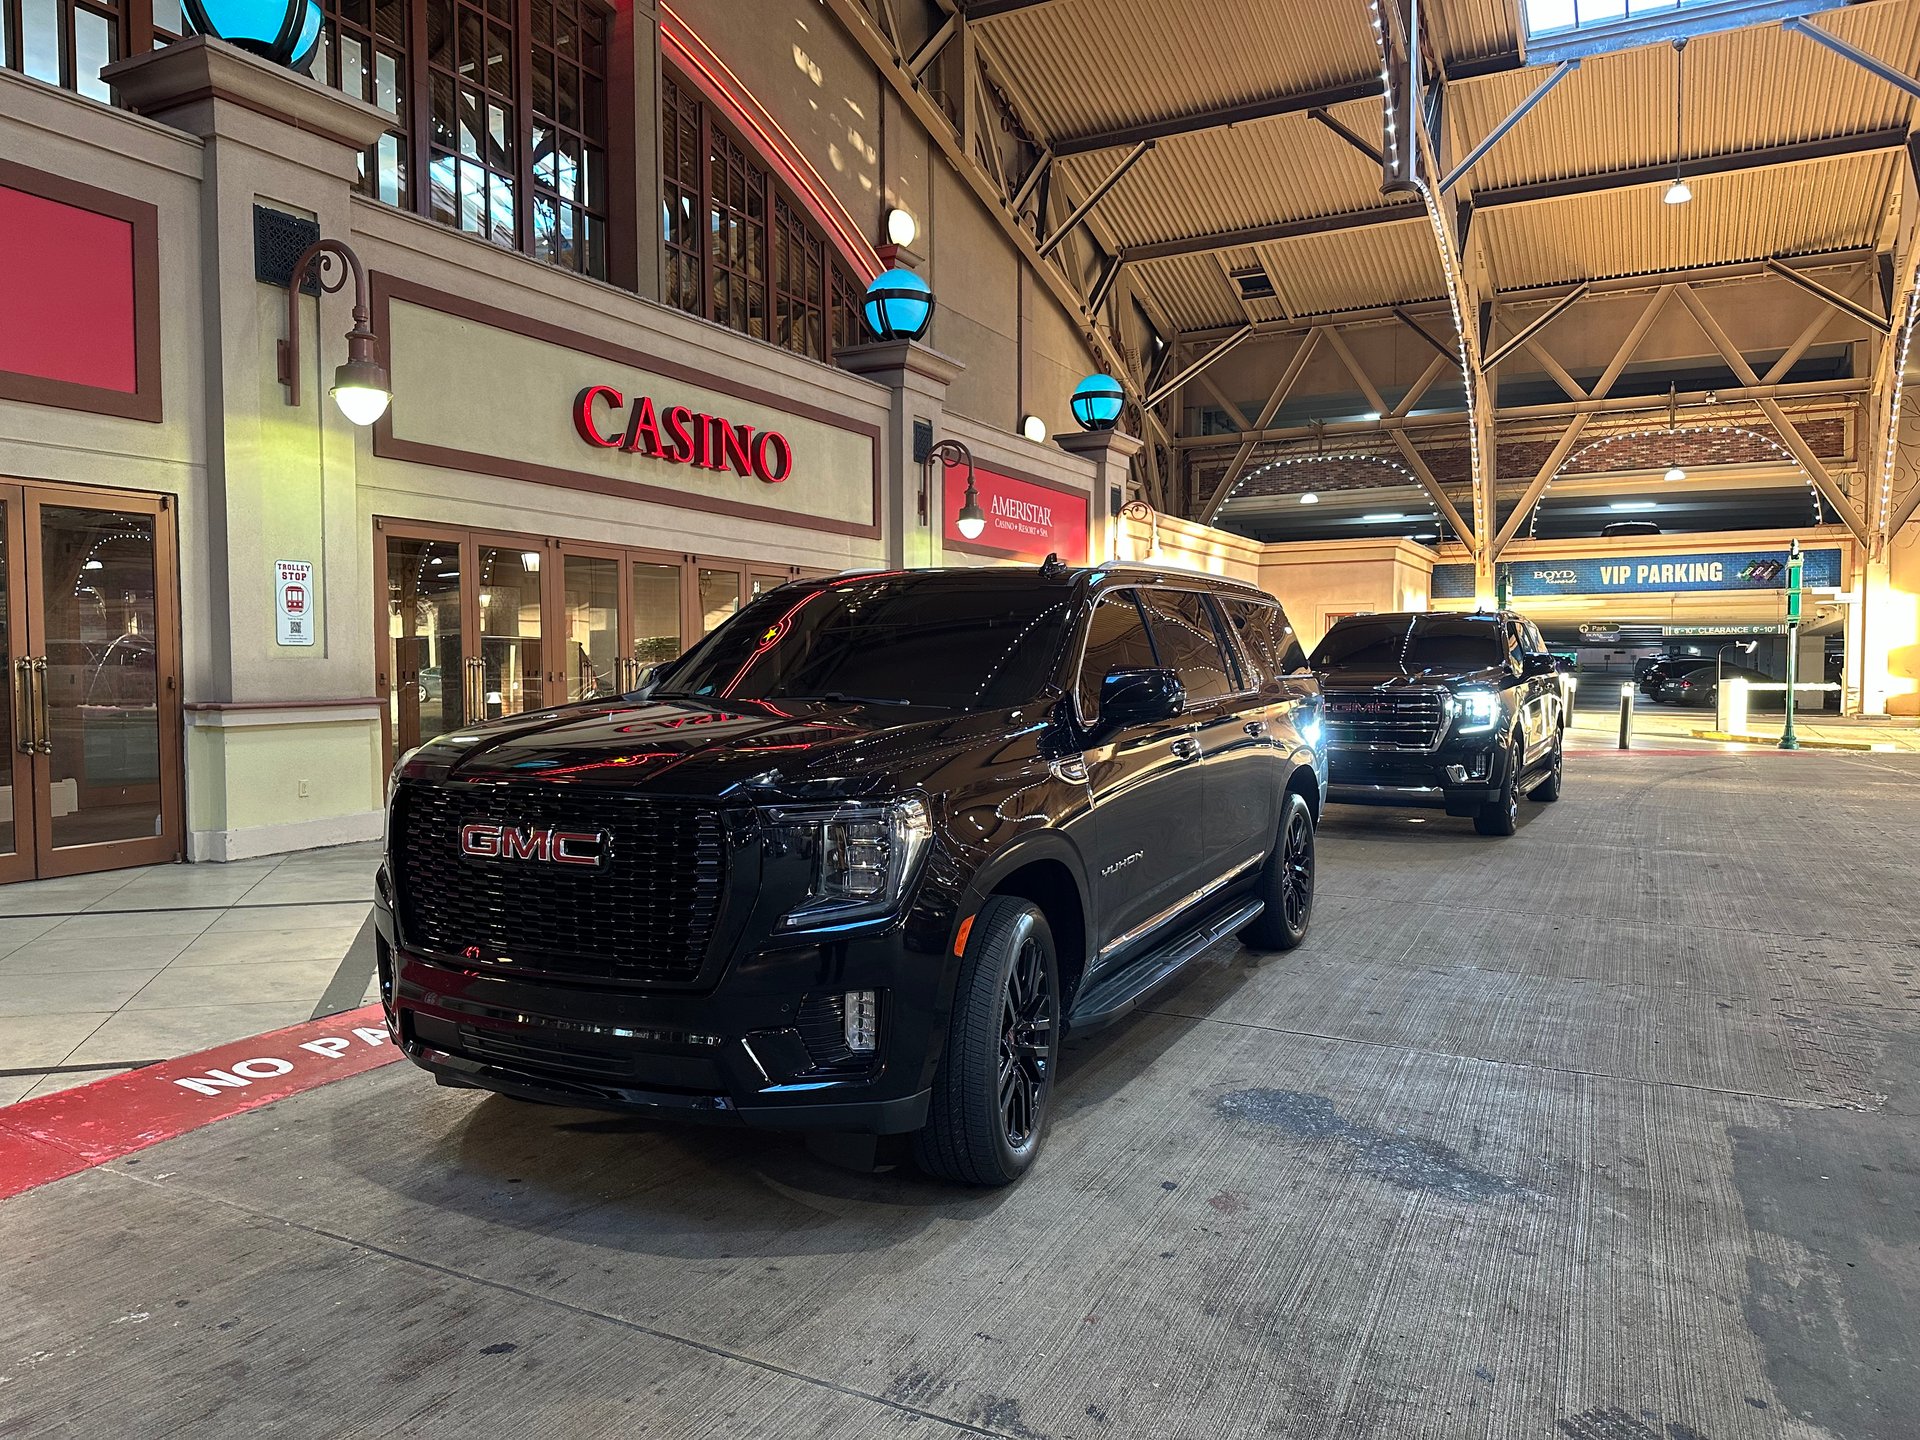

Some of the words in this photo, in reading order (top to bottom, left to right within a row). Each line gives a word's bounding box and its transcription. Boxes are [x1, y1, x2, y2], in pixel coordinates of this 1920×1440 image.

[573, 385, 792, 483] CASINO
[990, 494, 1053, 527] AMERISTAR
[277, 563, 311, 572] TROLLEY
[281, 571, 307, 581] STOP
[1533, 570, 1575, 580] BOYD
[1600, 565, 1631, 585] VIP
[1636, 562, 1724, 584] PARKING
[1698, 625, 1749, 634] CLEARANCE
[461, 824, 602, 866] GMC
[1101, 850, 1144, 877] YUKON
[173, 1057, 294, 1096] NO
[299, 1020, 390, 1059] PA
